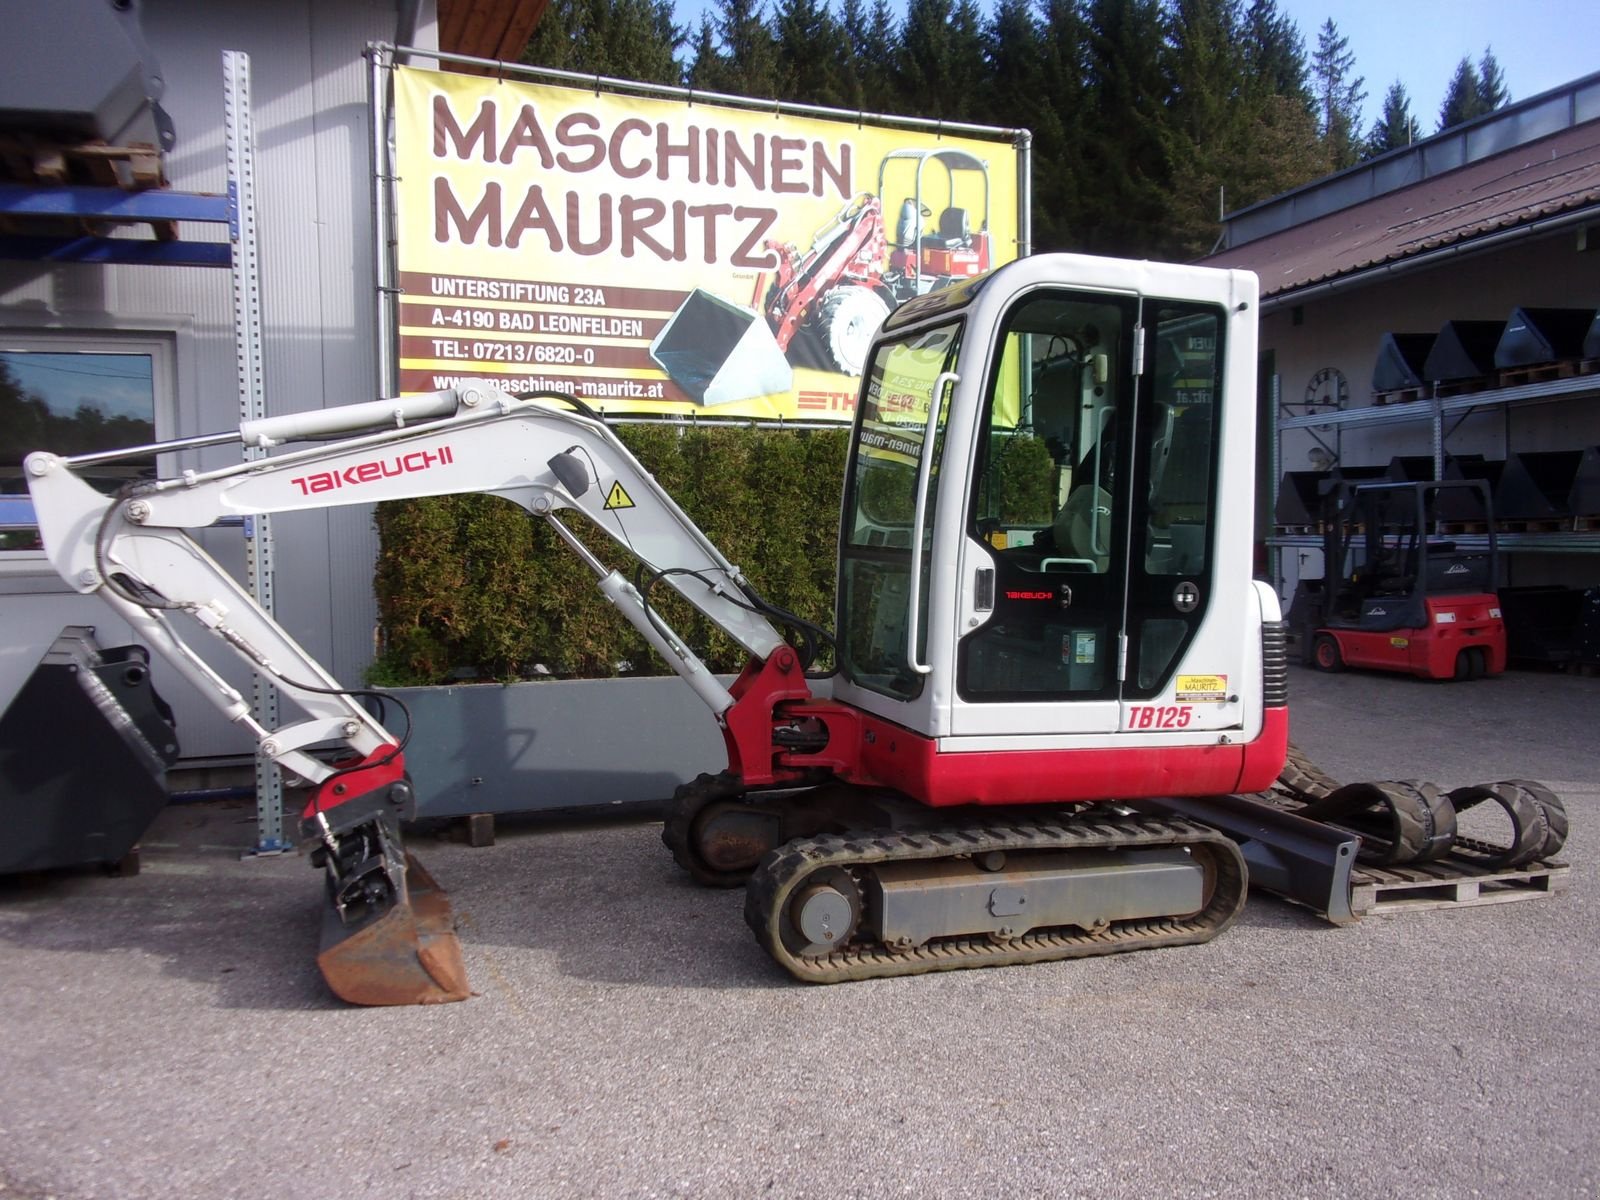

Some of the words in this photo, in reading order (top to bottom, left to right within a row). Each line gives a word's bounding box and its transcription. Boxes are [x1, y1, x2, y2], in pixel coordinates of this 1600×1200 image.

[433, 94, 852, 200] MASCHINEN
[434, 176, 778, 269] MAURITZ
[431, 277, 570, 304] UNTERSTIFTUNG
[574, 287, 606, 306] 23A
[431, 308, 495, 329] A-4190
[499, 312, 535, 331] BAD
[539, 314, 643, 337] LEONFELDEN
[431, 339, 469, 358] TEL:
[432, 375, 664, 398] wwmaschinen-mauritz.at
[1128, 706, 1193, 729] TB125
